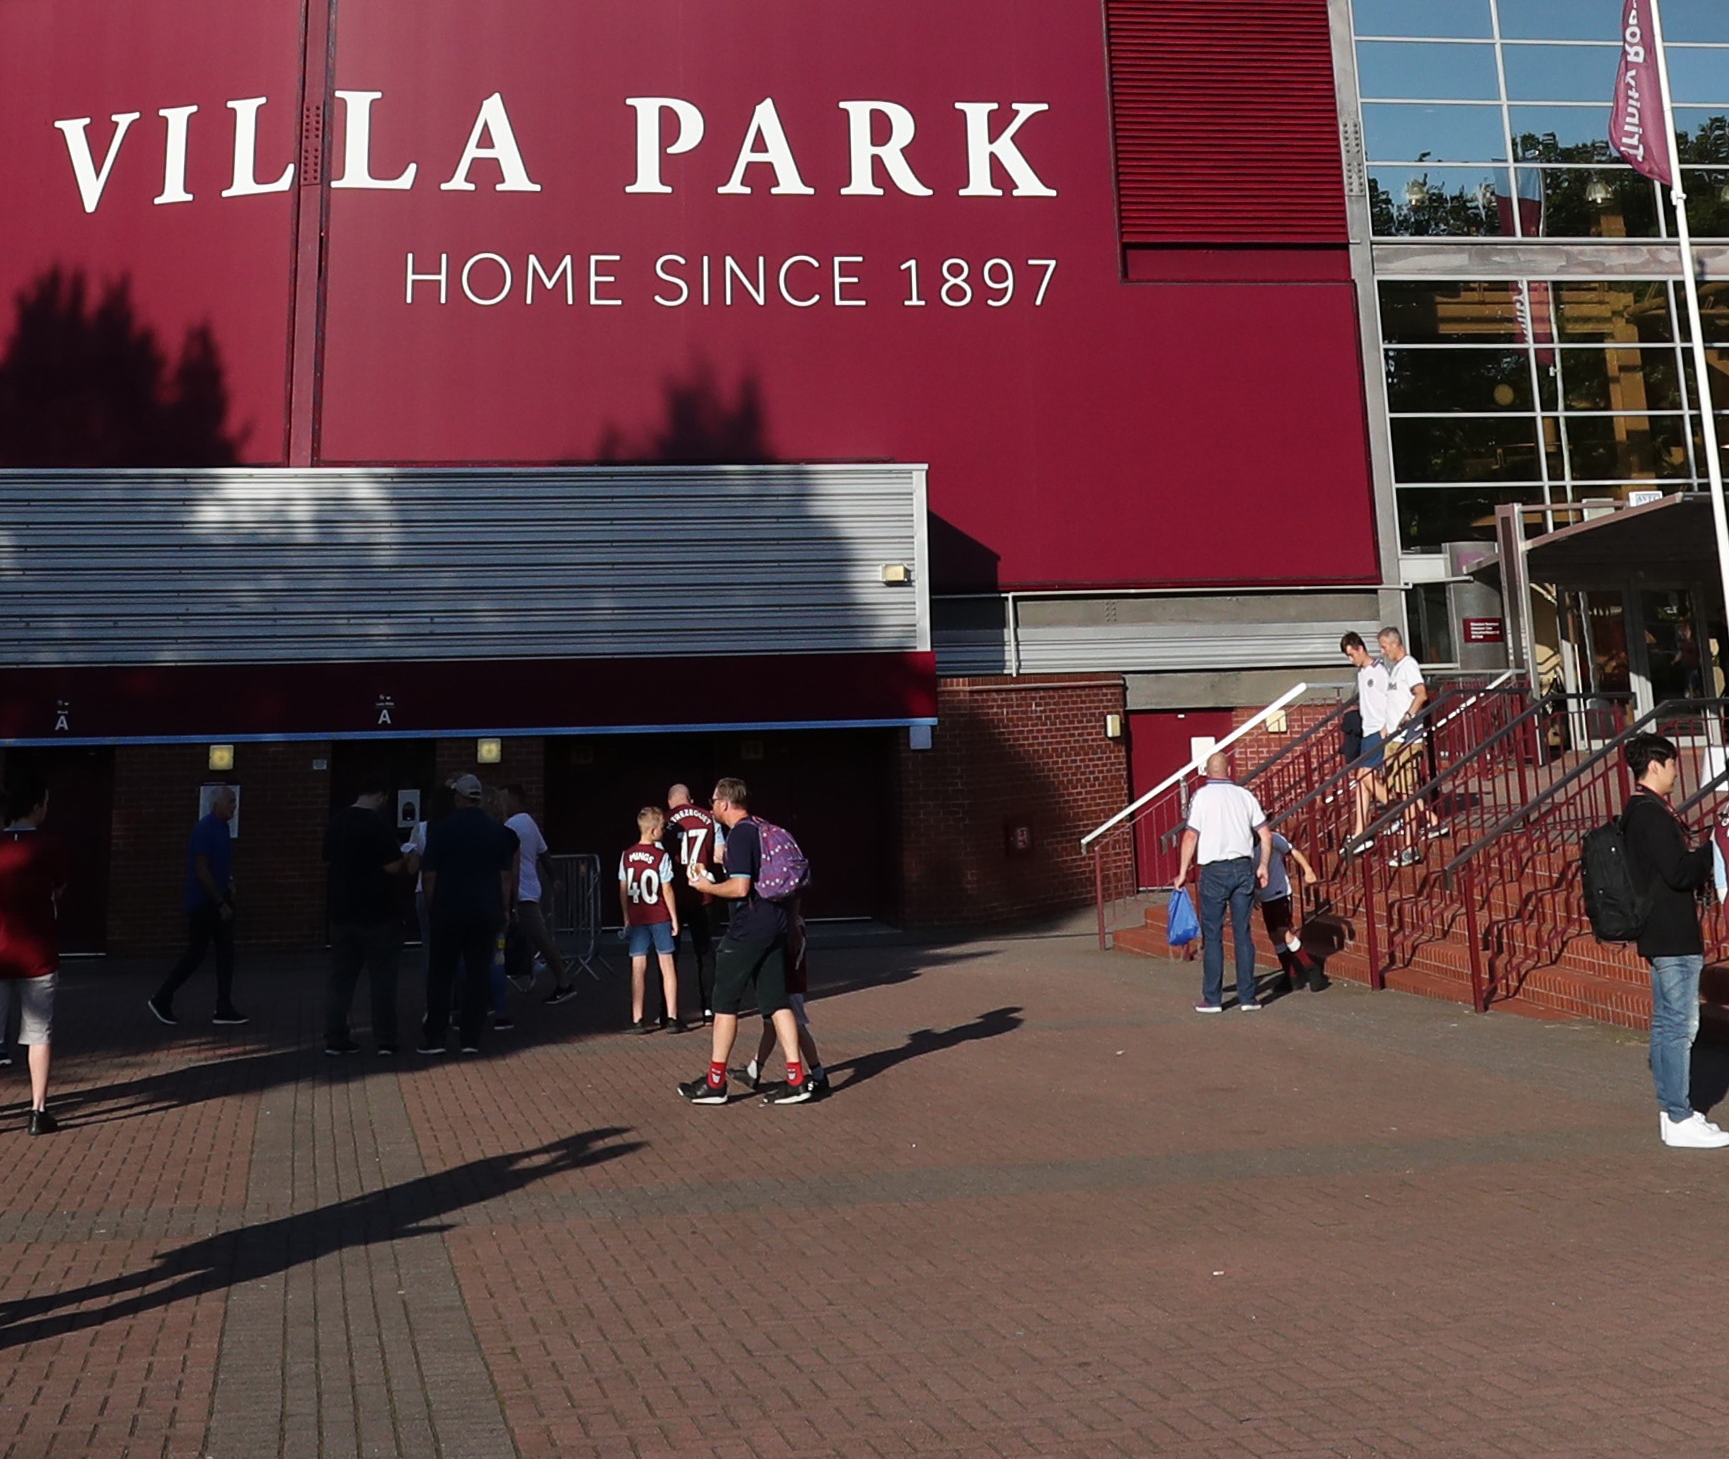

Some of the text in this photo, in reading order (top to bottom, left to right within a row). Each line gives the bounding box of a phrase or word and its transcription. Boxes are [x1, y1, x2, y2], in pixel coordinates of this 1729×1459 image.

[54, 90, 1057, 213] VILLA PARK
[406, 252, 1057, 308] HOME SINCE 1897
[55, 715, 69, 730] A
[378, 709, 391, 724] A
[629, 852, 654, 864] MINGS
[677, 828, 708, 866] 17
[627, 867, 659, 904] 40
